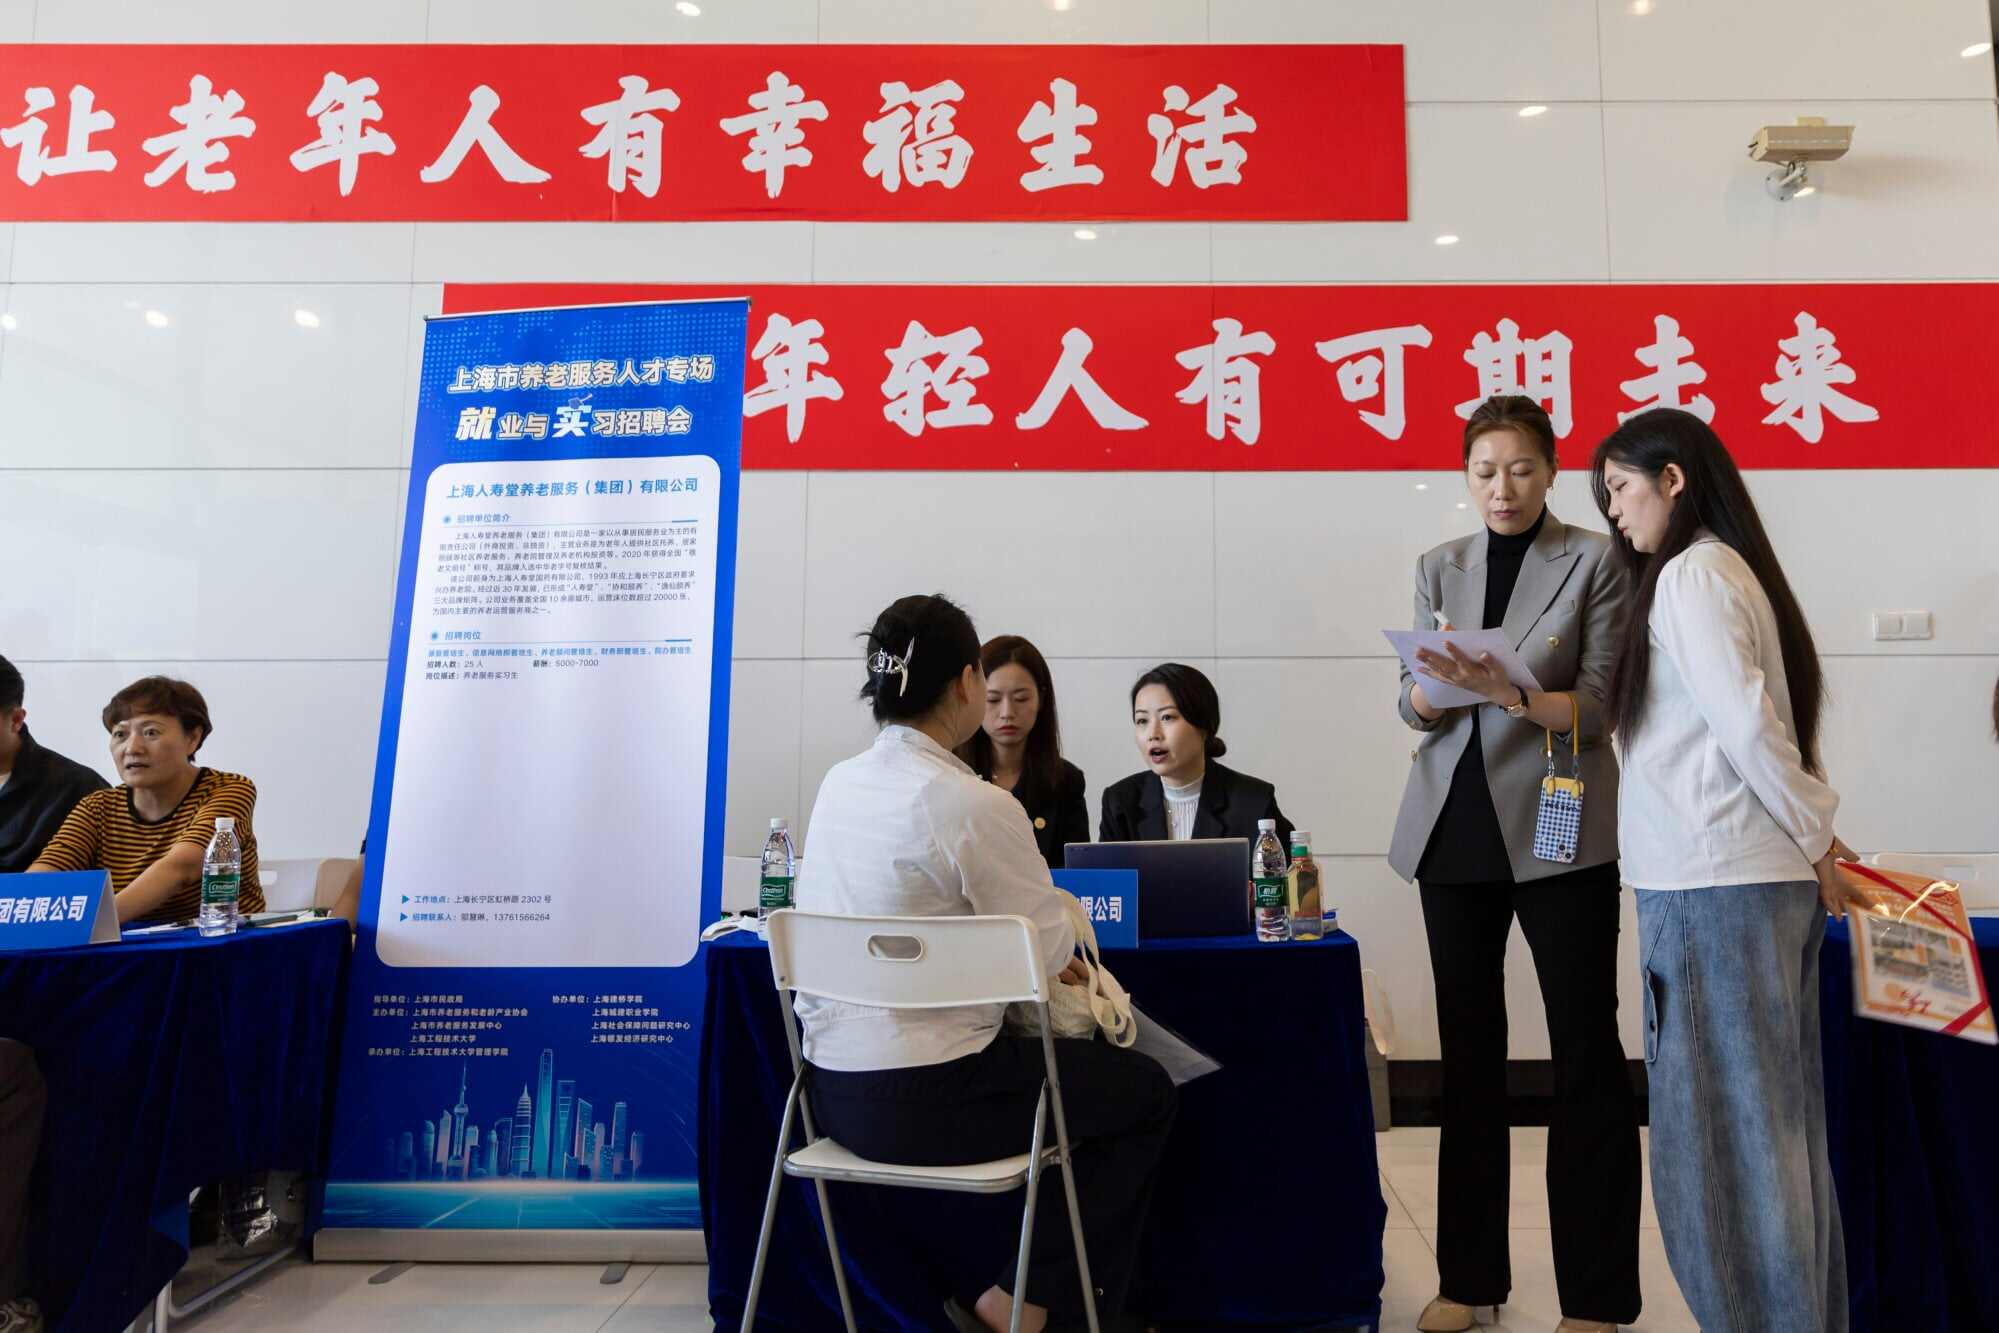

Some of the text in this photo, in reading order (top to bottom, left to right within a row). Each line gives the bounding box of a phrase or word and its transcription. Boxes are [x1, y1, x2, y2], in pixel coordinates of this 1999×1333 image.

[0, 72, 1257, 198] 让老年人有幸福生活
[448, 355, 714, 393] 上海市养老服务人才专场
[743, 312, 1879, 444] 年轻人有可期未来
[455, 404, 692, 441] 就业与实习招聘会
[446, 478, 698, 499] 上海人寿堂养老服务（集团）有限公司
[445, 631, 482, 641] 招聘岗位
[1079, 895, 1122, 922] 限公司
